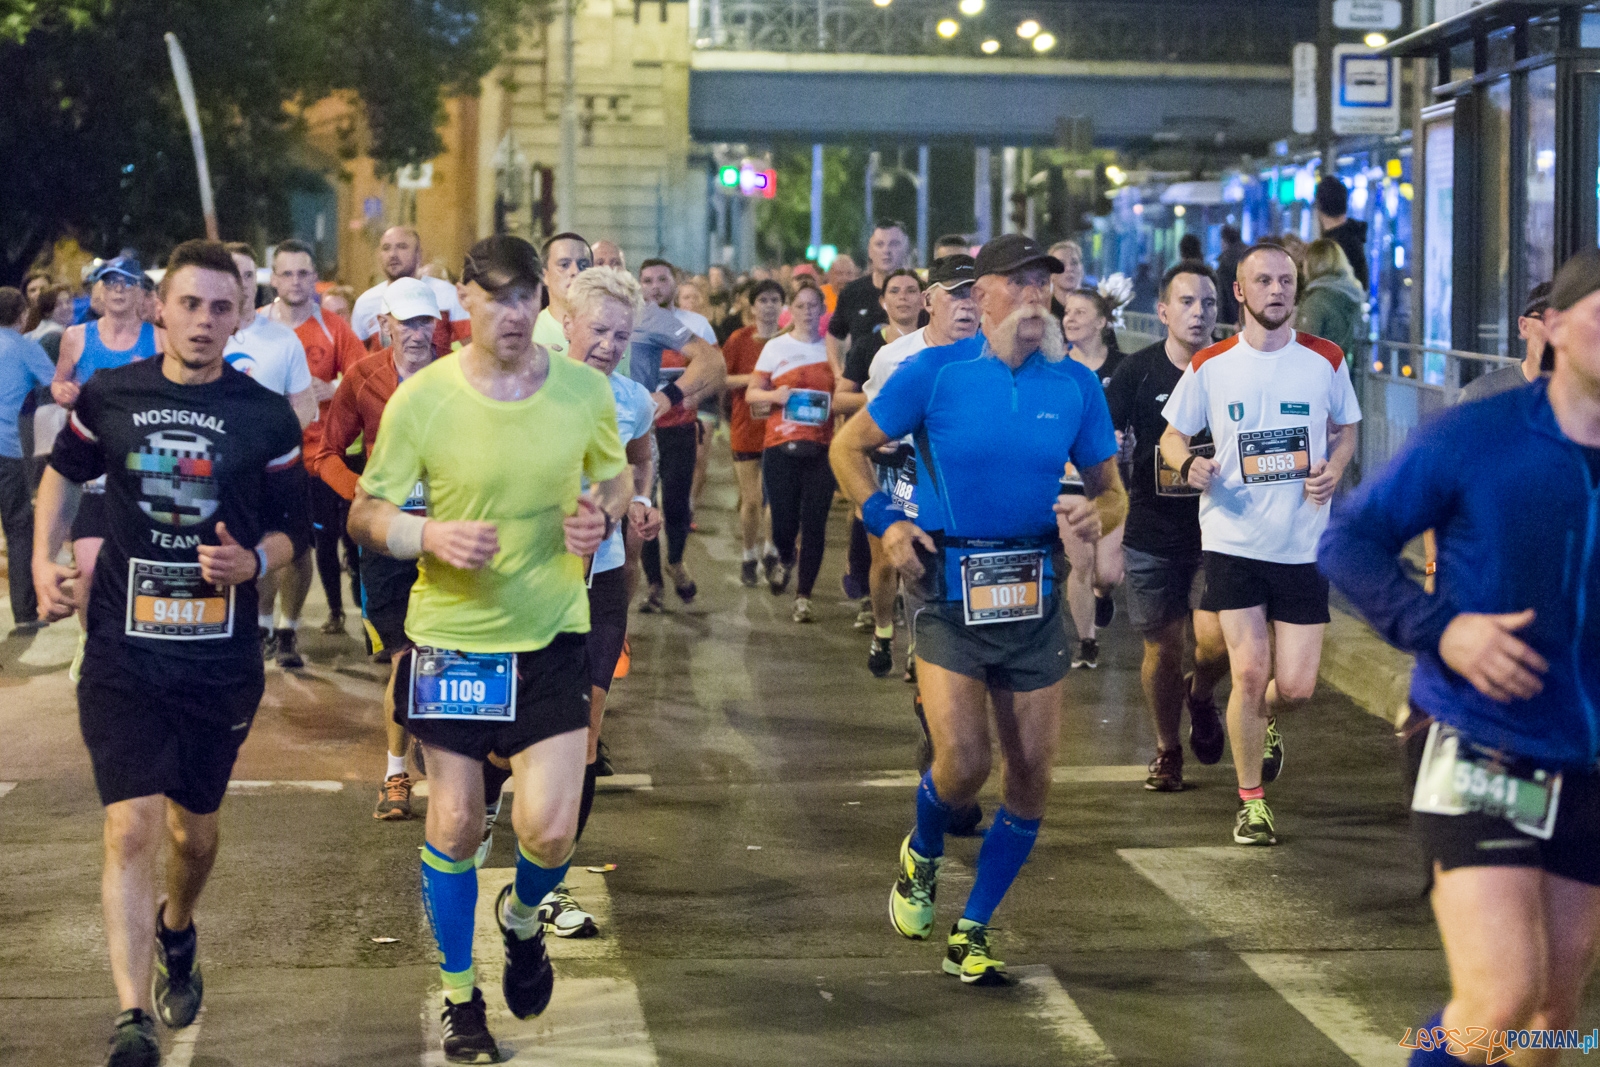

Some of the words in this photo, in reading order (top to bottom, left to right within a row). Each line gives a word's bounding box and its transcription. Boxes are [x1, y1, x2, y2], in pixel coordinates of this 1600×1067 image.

[132, 409, 226, 434] NOSIGNAL
[1257, 454, 1295, 473] 9953
[150, 529, 202, 549] TEAM
[990, 585, 1027, 607] 1012
[153, 600, 206, 623] 9447
[438, 679, 486, 703] 1109
